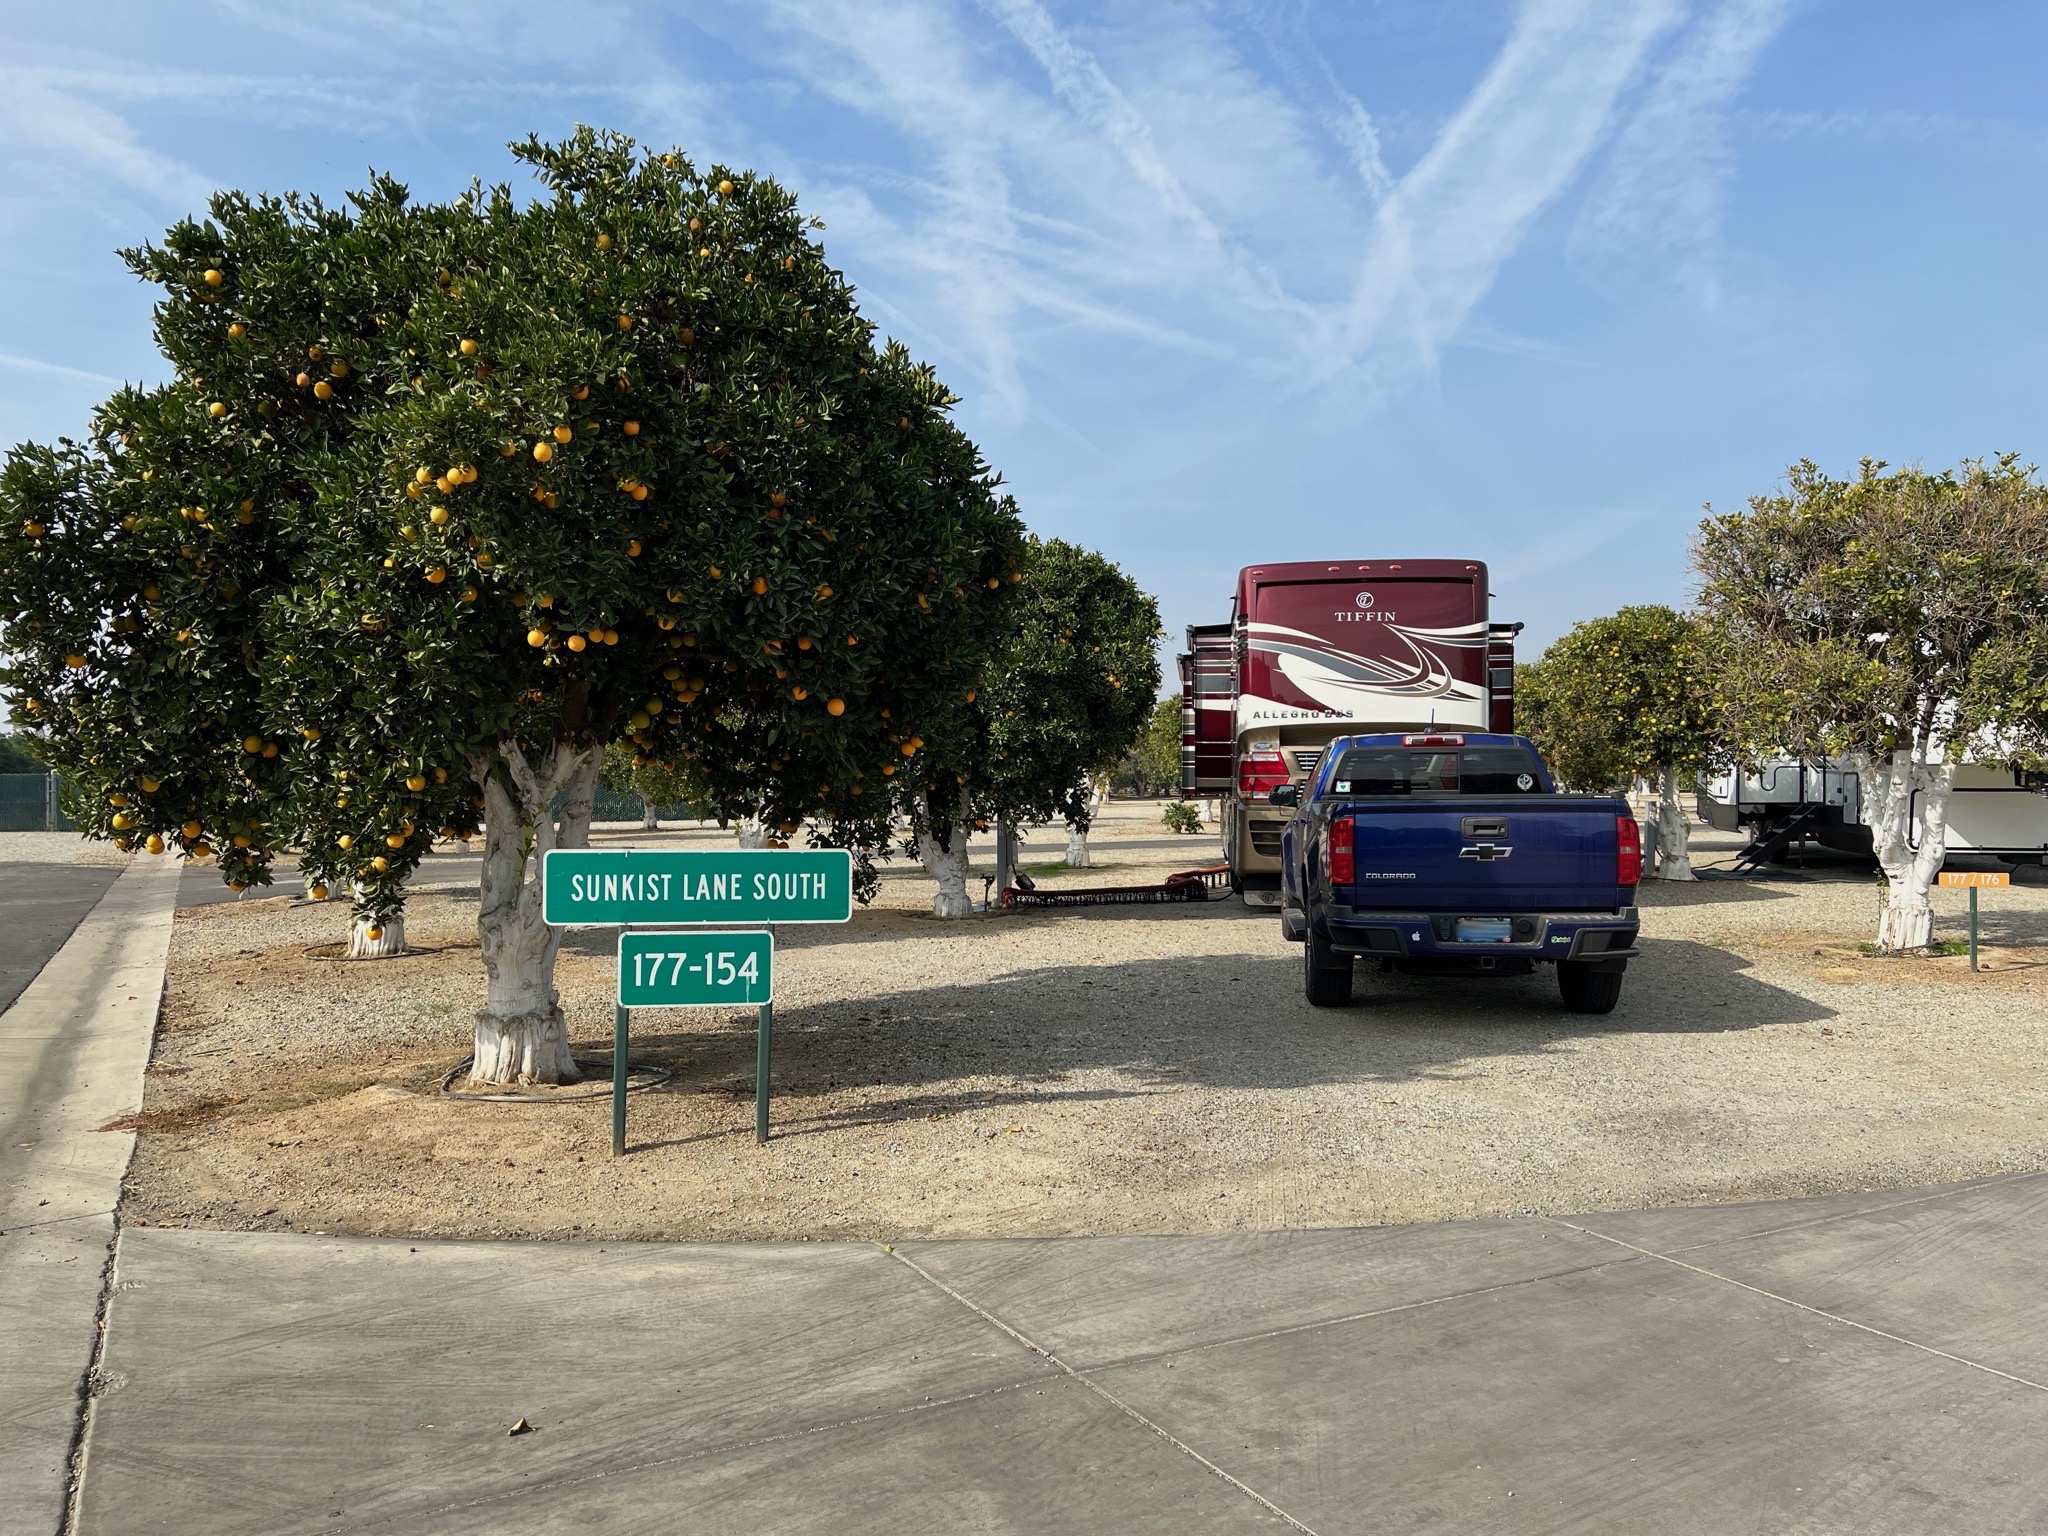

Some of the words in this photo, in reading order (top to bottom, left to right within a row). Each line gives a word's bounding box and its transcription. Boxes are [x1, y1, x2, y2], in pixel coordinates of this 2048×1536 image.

[1334, 612, 1396, 622] TIFFIN
[1253, 710, 1320, 719] ALLEGRO
[1324, 709, 1354, 719] BUS
[1947, 874, 1967, 885] 177
[1981, 874, 2000, 885] 176
[571, 874, 672, 901] SUNKIST
[683, 873, 743, 900] LANE
[753, 872, 826, 900] SOUTH
[633, 951, 759, 987] 177-154
